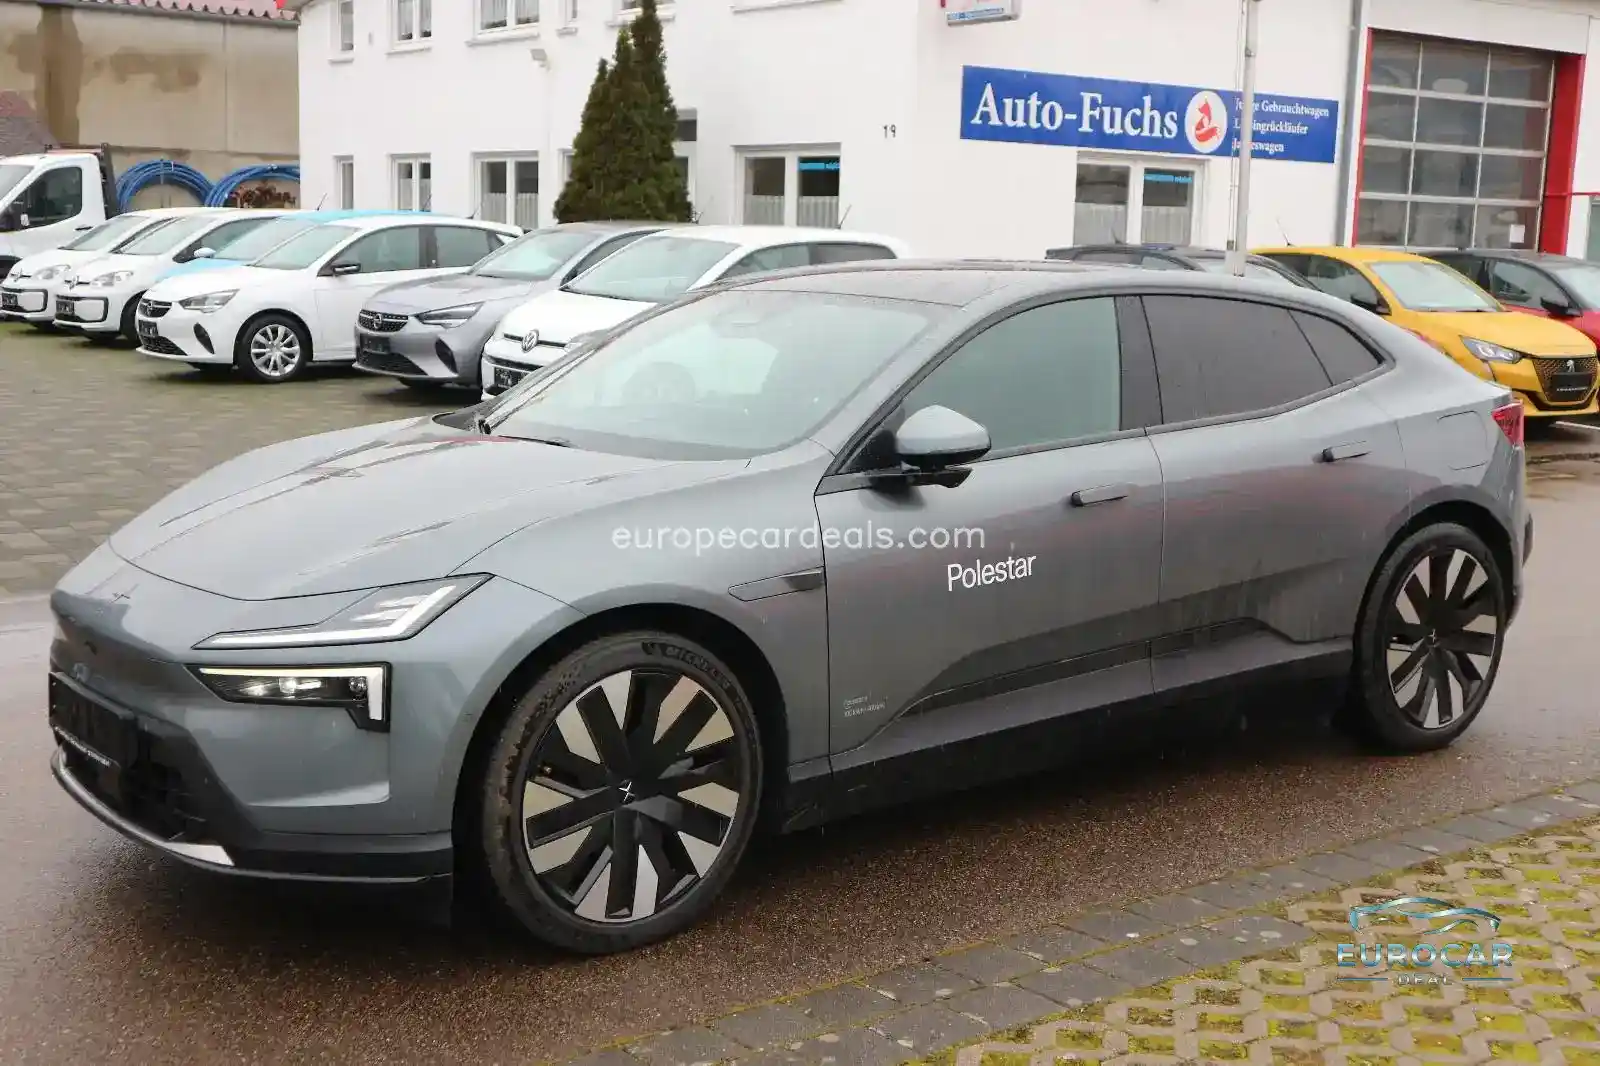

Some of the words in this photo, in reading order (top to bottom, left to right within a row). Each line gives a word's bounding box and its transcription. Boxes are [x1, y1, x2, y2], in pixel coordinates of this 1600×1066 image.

[970, 82, 1178, 139] Auto-Fuchs
[1261, 100, 1329, 119] Gebrauchtwagen
[883, 124, 896, 138] 19
[947, 555, 1037, 591] Polestar
